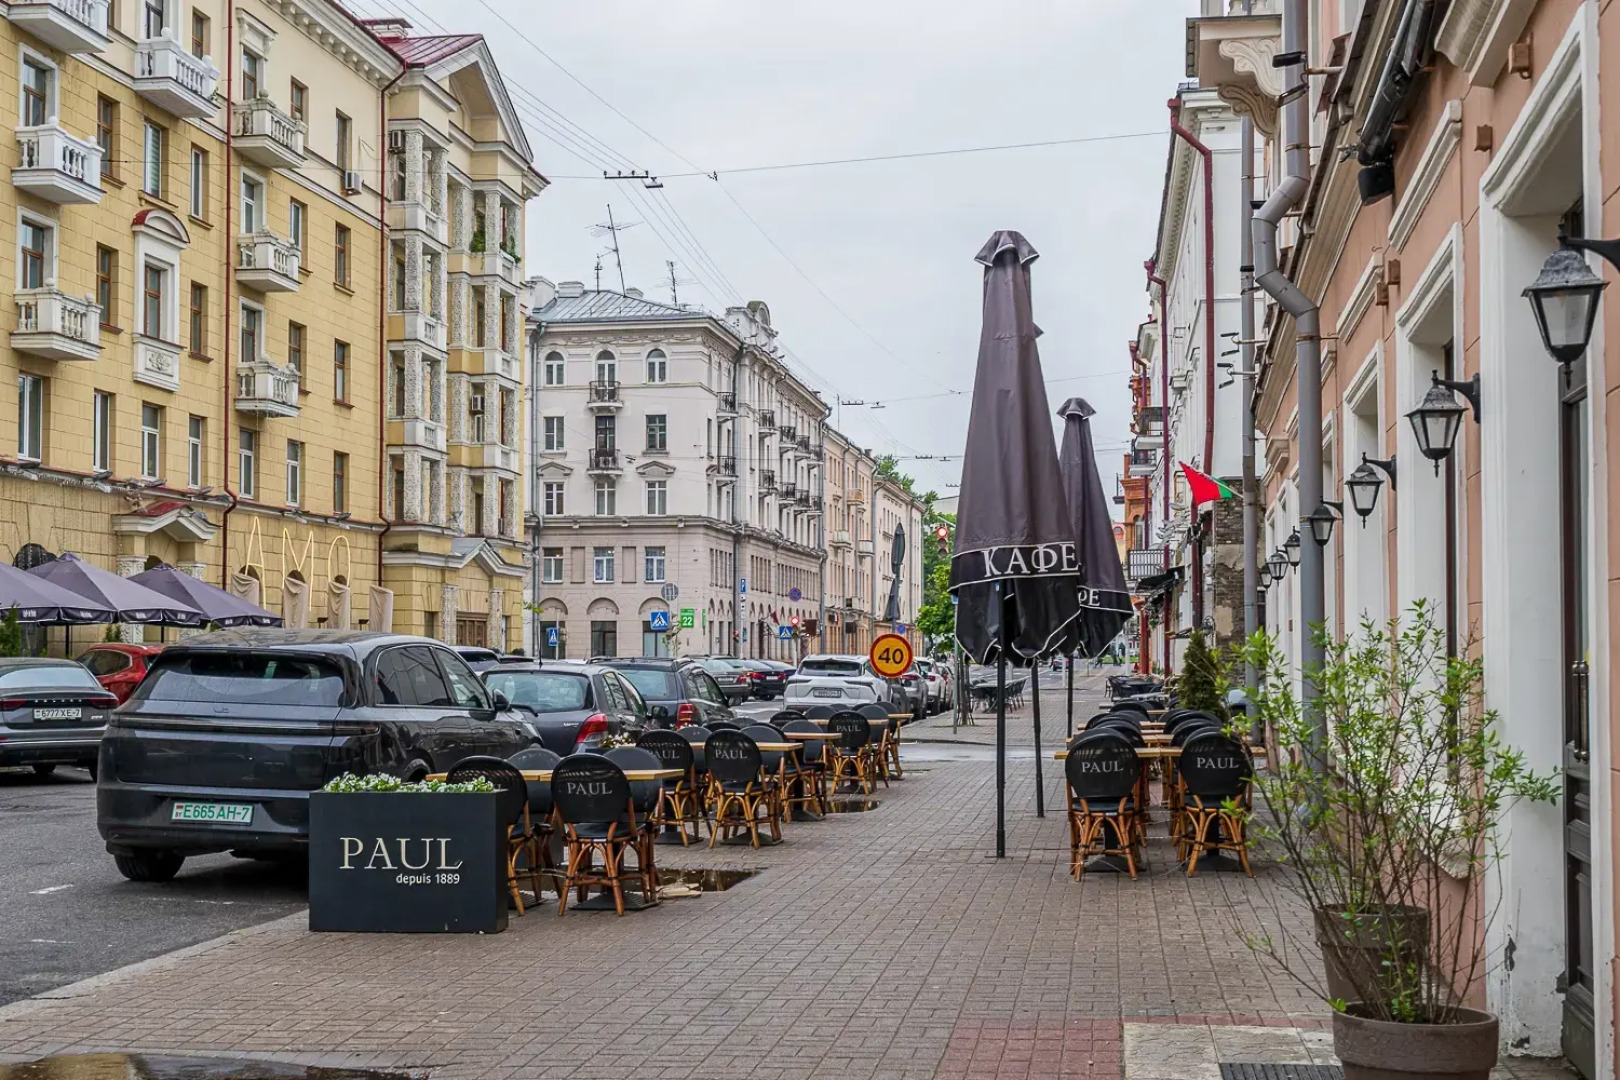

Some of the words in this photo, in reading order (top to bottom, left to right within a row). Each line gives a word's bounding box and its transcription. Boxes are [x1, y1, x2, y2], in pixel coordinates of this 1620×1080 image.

[245, 516, 351, 611] AMO
[982, 543, 1081, 577] КАФЕ
[682, 616, 693, 626] 22
[878, 648, 904, 664] 40
[715, 749, 747, 759] PAUL
[1081, 761, 1124, 773] PAUL
[1196, 757, 1239, 769] PAUL
[566, 782, 613, 795] PAUL
[339, 837, 463, 870] PAUL
[396, 873, 431, 886] depuis
[435, 873, 460, 884] 1889
